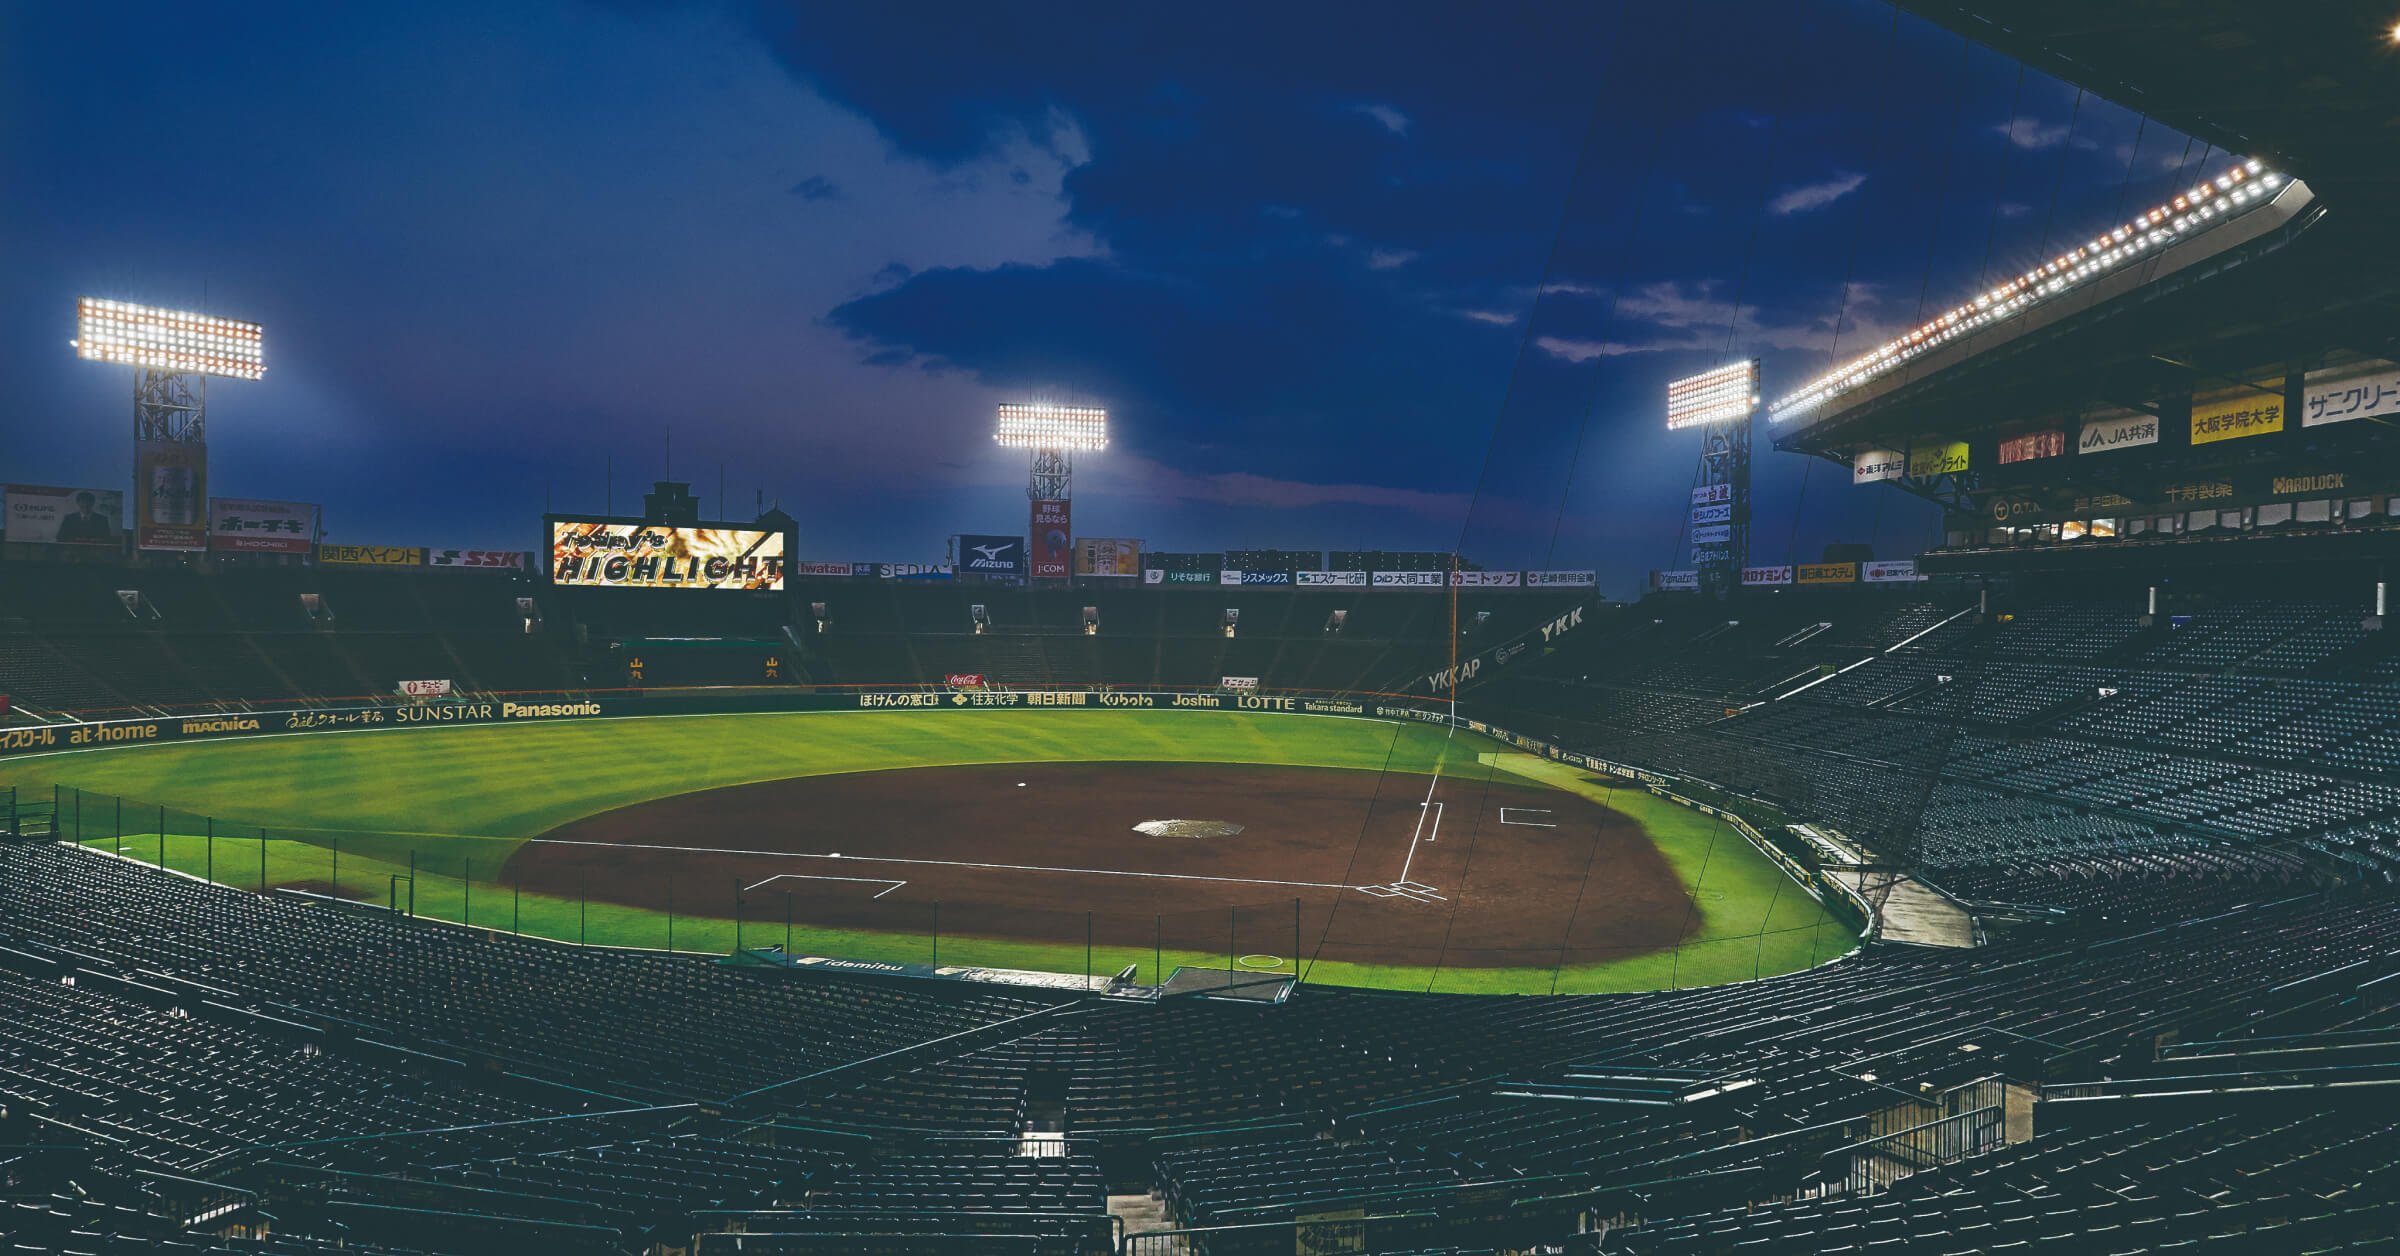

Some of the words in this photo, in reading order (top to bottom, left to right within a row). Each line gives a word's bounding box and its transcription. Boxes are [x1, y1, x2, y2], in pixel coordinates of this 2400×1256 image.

[2309, 381, 2400, 419] サニクリー
[2194, 405, 2281, 435] 大阪学院大学
[2109, 423, 2156, 444] JA共済
[2273, 473, 2344, 494] HARDLOCK
[2164, 485, 2232, 504] 千寿製薬
[219, 516, 304, 533] ホーチキ
[1036, 514, 1068, 524] 見るなら
[561, 531, 668, 552] Today's
[321, 547, 418, 565] 関西ペイント
[463, 552, 521, 567] SSK
[556, 556, 784, 587] HIGHLIGHT
[800, 563, 850, 575] Iwatani
[880, 564, 942, 577] SEDIA
[1038, 563, 1065, 574] J:COM
[1171, 572, 1211, 583] りそな銀行
[1242, 573, 1288, 583] シスメックス
[1311, 572, 1365, 584] エスケー化研
[1395, 573, 1442, 585] 大同工業
[1452, 573, 1518, 585] カニトップ
[1542, 606, 1583, 642] YKK
[1429, 665, 1459, 693] YKK
[1460, 658, 1481, 682] AP
[859, 694, 934, 707] ほけんの窓口
[971, 693, 1018, 706] 住友化学
[1027, 692, 1086, 705] 朝日新聞
[1100, 692, 1153, 706] Kubota
[1172, 694, 1220, 707] Joshin
[1238, 697, 1295, 710] LOTTE
[502, 702, 601, 719] Panasonic
[1304, 702, 1329, 711] Takara
[1329, 705, 1363, 713] standard
[396, 705, 493, 724] SUNSTAR
[70, 728, 92, 744] at
[95, 722, 157, 742] home
[825, 959, 904, 972] idemitsu
